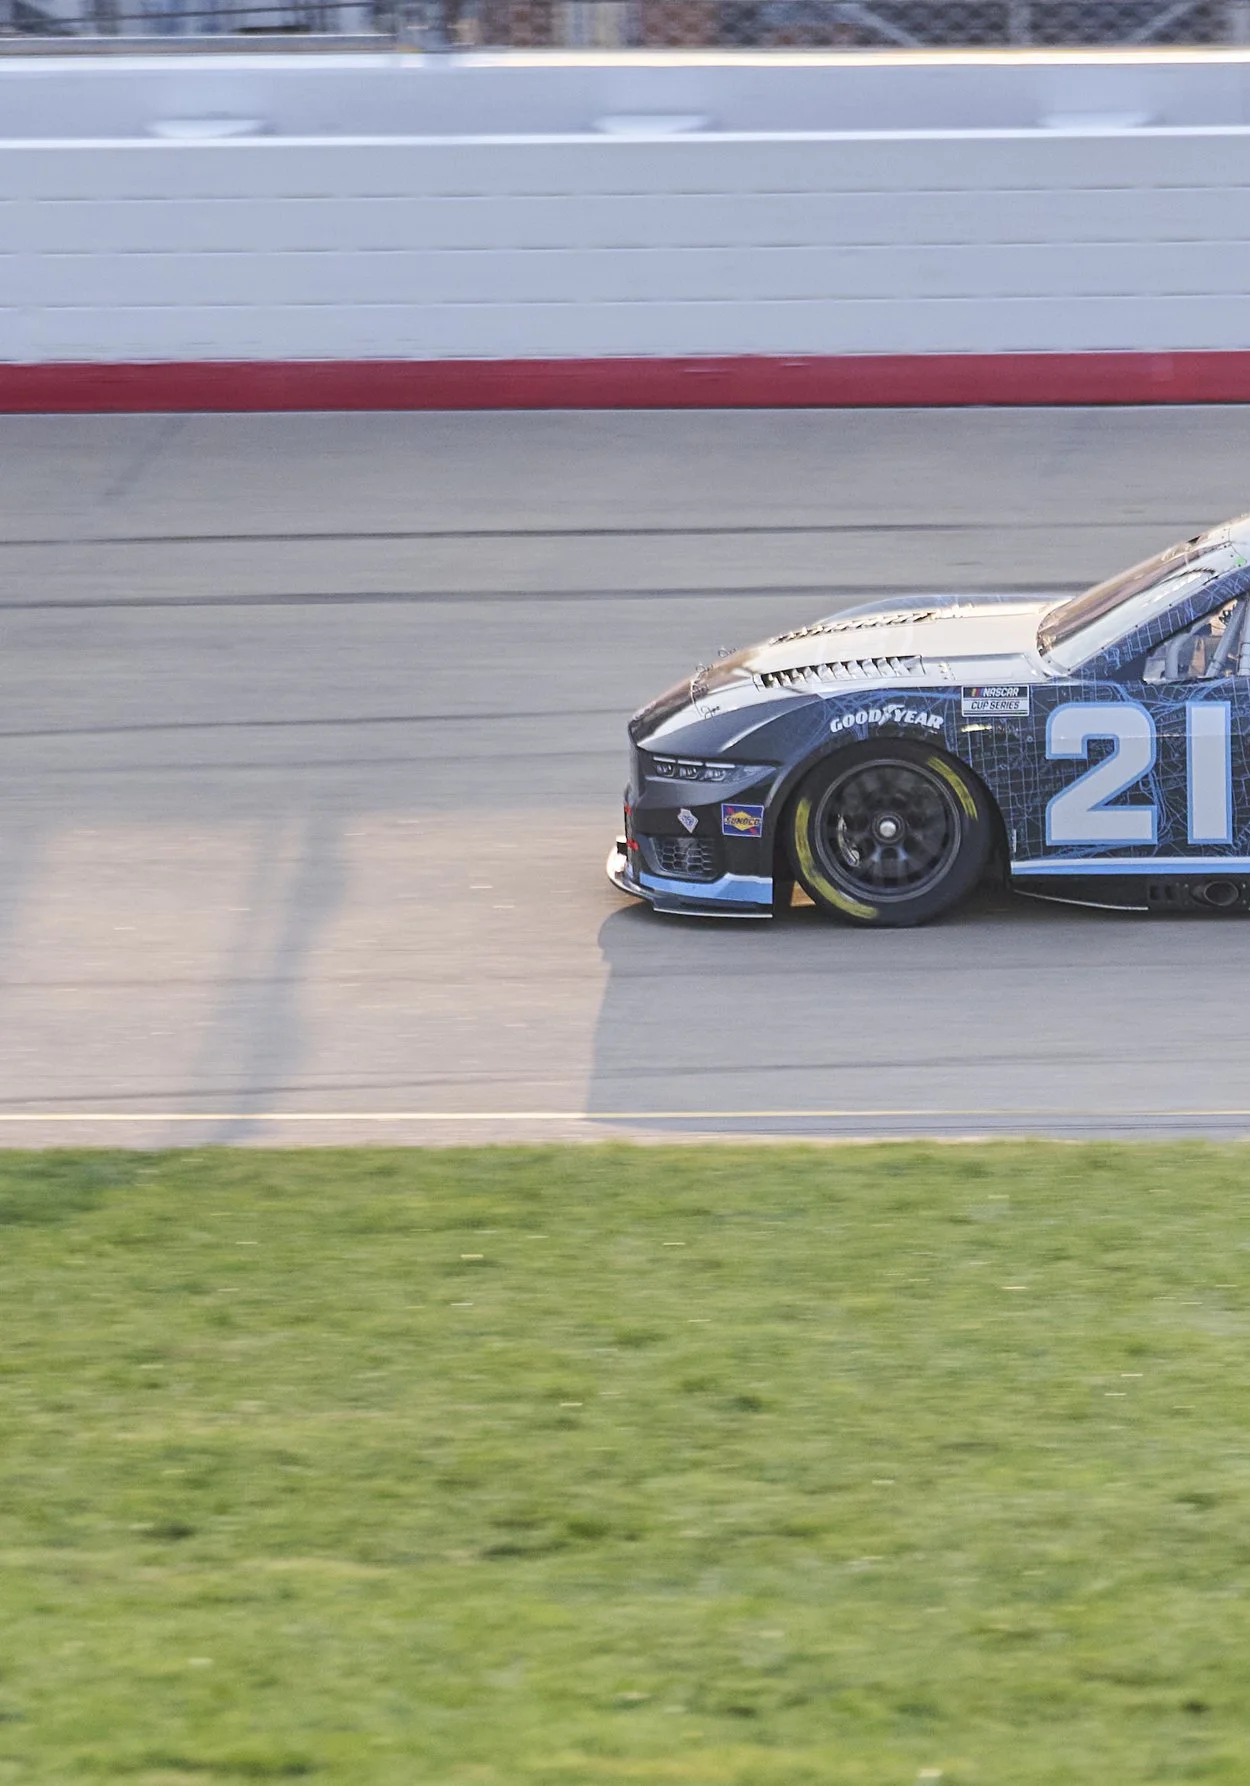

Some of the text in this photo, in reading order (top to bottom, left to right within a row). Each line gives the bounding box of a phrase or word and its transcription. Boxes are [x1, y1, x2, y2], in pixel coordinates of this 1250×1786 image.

[982, 687, 1020, 697] NASCAR
[971, 701, 1020, 710] CUP SERIES
[830, 704, 944, 733] GOODYEAR
[1045, 700, 1233, 846] 21
